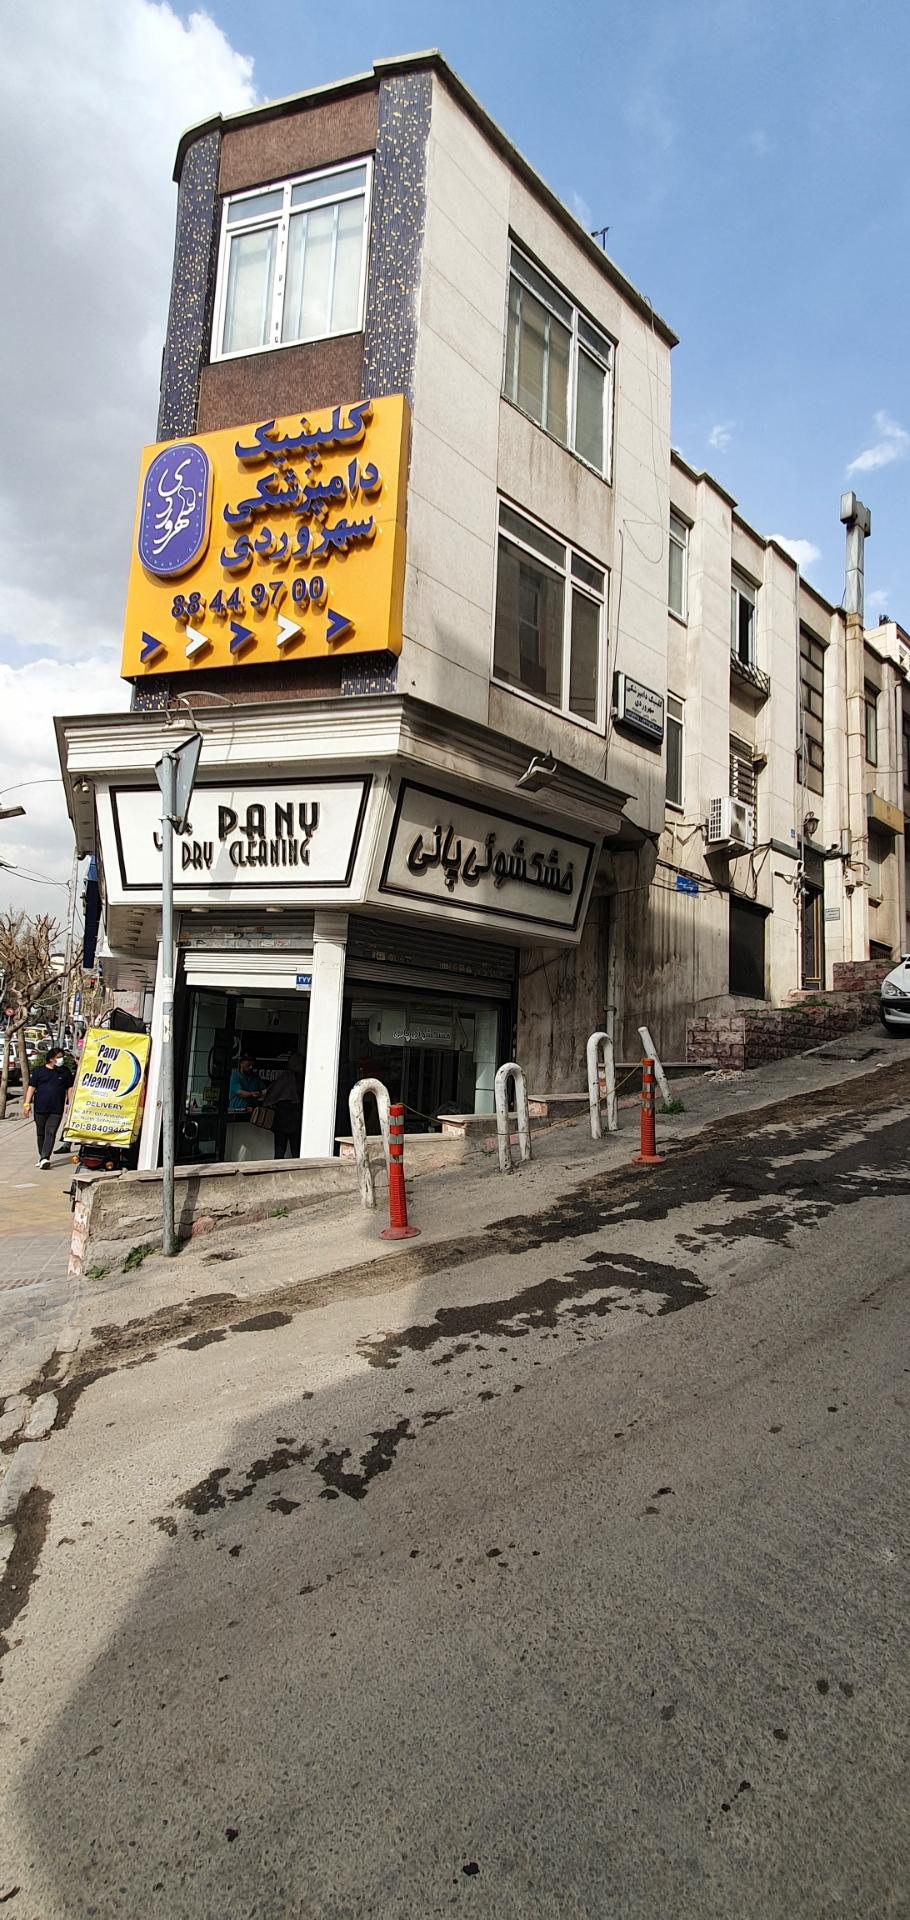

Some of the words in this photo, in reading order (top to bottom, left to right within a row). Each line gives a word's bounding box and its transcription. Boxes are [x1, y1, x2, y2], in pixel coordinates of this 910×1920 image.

[235, 401, 372, 466] کلینیک
[223, 457, 380, 522] دامپزشکی
[220, 514, 374, 568] سهروردی
[171, 592, 201, 618] 88
[209, 587, 240, 613] 44
[250, 581, 284, 607] 97
[292, 575, 324, 602] 00
[218, 801, 320, 842] PANY
[182, 840, 214, 871] DRY
[229, 837, 311, 867] CLEANING
[95, 1060, 111, 1075] Dry
[98, 1044, 120, 1060] Pany
[82, 1073, 121, 1092] Cleaning
[86, 1100, 124, 1110] DELIVERY
